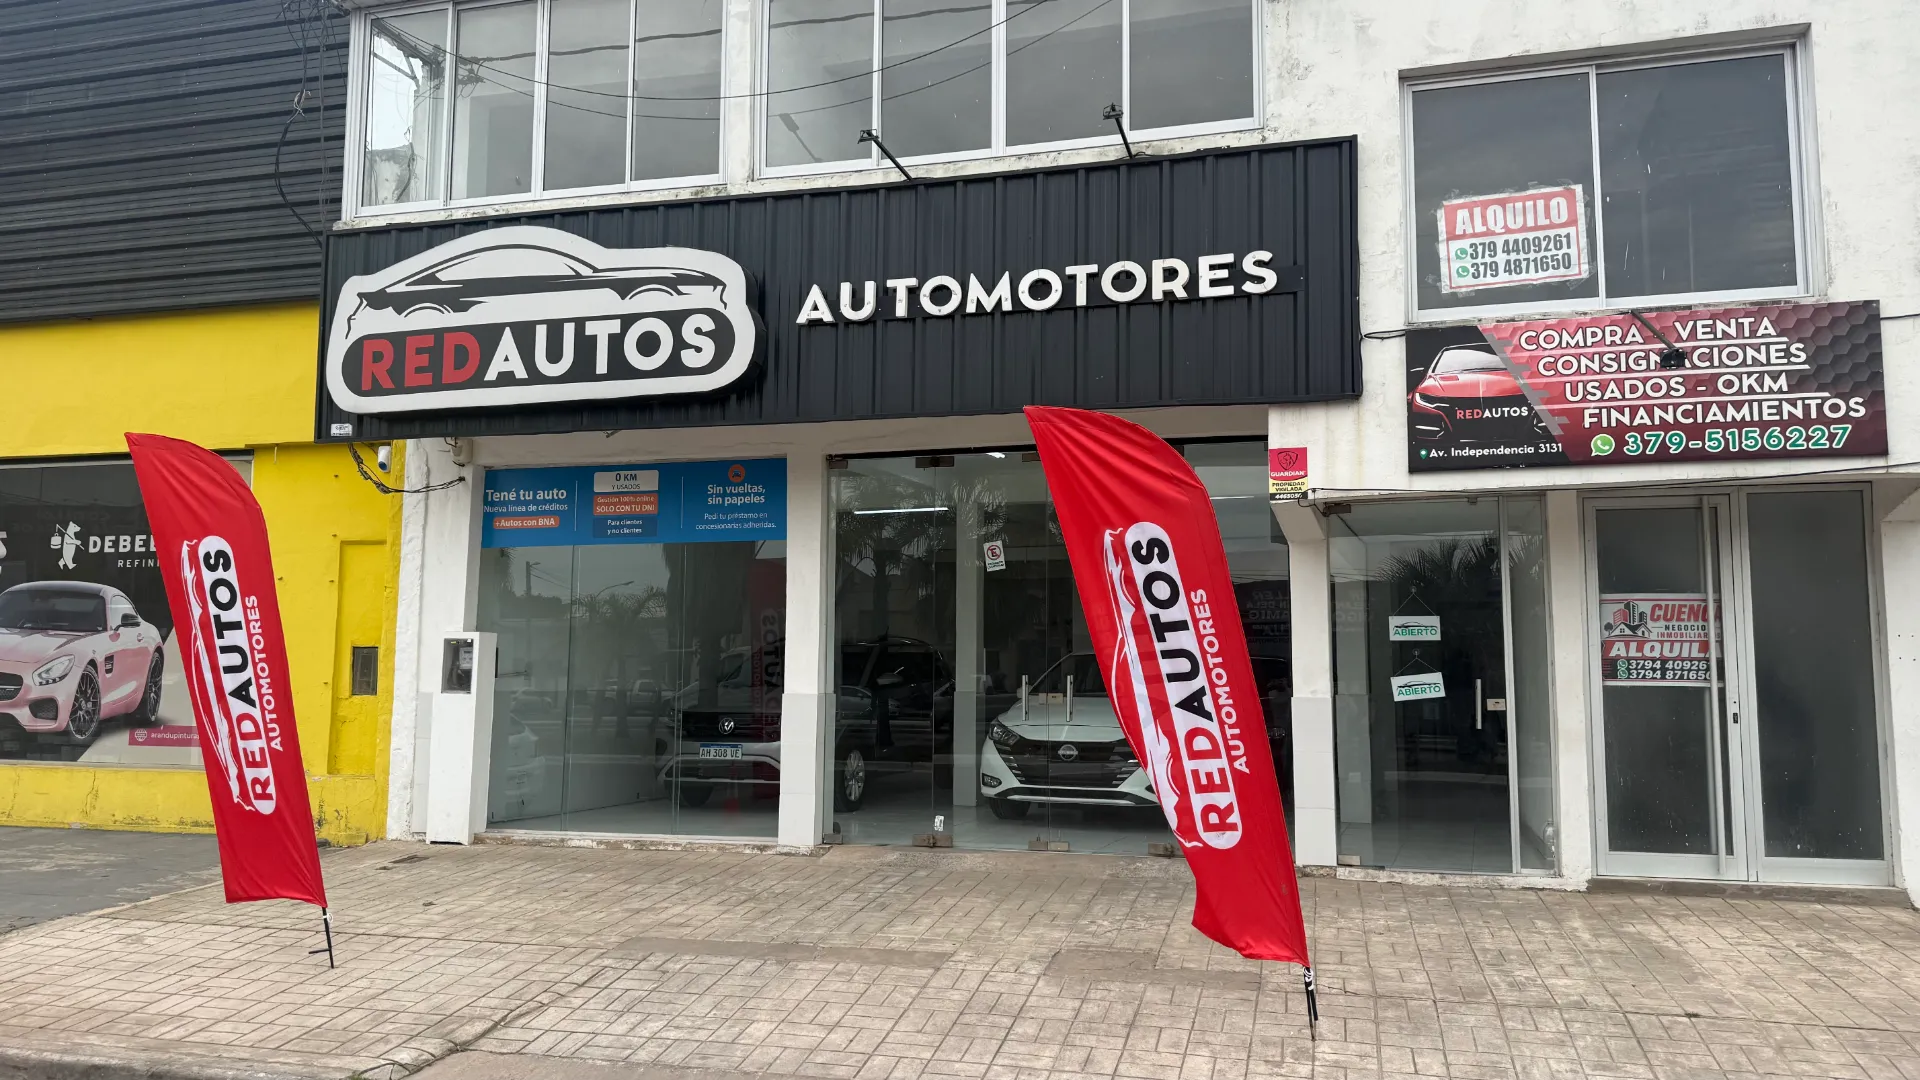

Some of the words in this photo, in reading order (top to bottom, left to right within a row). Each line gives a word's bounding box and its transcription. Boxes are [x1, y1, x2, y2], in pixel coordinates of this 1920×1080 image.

[1455, 197, 1568, 235] ALQUILO
[1469, 241, 1497, 260] 379
[1502, 232, 1571, 256] 4409261
[1471, 261, 1499, 279] 379
[1503, 252, 1572, 276] 4871650
[795, 249, 1278, 324] AUTOMOTORES
[1519, 324, 1644, 350] COMPRA
[1674, 316, 1777, 341] VENTA
[361, 314, 716, 391] REDAUTOS
[1537, 342, 1809, 376] CONSIGNCIONES
[1564, 377, 1686, 402] USADOS
[1456, 406, 1528, 419] REDAUTOS
[1583, 396, 1866, 428] FINANCIAMIENTOS
[1623, 424, 1852, 455] 379-5156227
[1429, 449, 1447, 458] Av.
[1451, 445, 1534, 458] Independencia
[1539, 443, 1562, 453] 3131
[623, 473, 637, 481] KM
[486, 488, 516, 501] Tené
[519, 489, 532, 500] tu
[536, 488, 566, 500] auto
[707, 484, 723, 494] Sin
[726, 482, 766, 494] vueltas,
[707, 495, 722, 505] sin
[724, 493, 765, 506] papeles
[484, 505, 507, 513] Nueva
[508, 504, 526, 512] línea
[527, 504, 537, 512] de
[538, 503, 568, 511] créditos
[596, 505, 615, 513] SOLO
[495, 519, 521, 527] +Autos
[538, 518, 555, 526] BNA
[607, 528, 612, 536] y
[1394, 628, 1438, 636] ABIERTO
[1629, 660, 1661, 669] 3794
[1665, 660, 1710, 669] 40926
[203, 550, 274, 801] REDAUTOS
[245, 595, 283, 751] AUTOMOTORES
[1630, 670, 1662, 679] 3794
[1131, 537, 1238, 832] REDAUTOS
[1190, 588, 1250, 774] AUTOMOTORES
[1397, 685, 1441, 697] ABIERTO
[713, 748, 728, 758] 308
